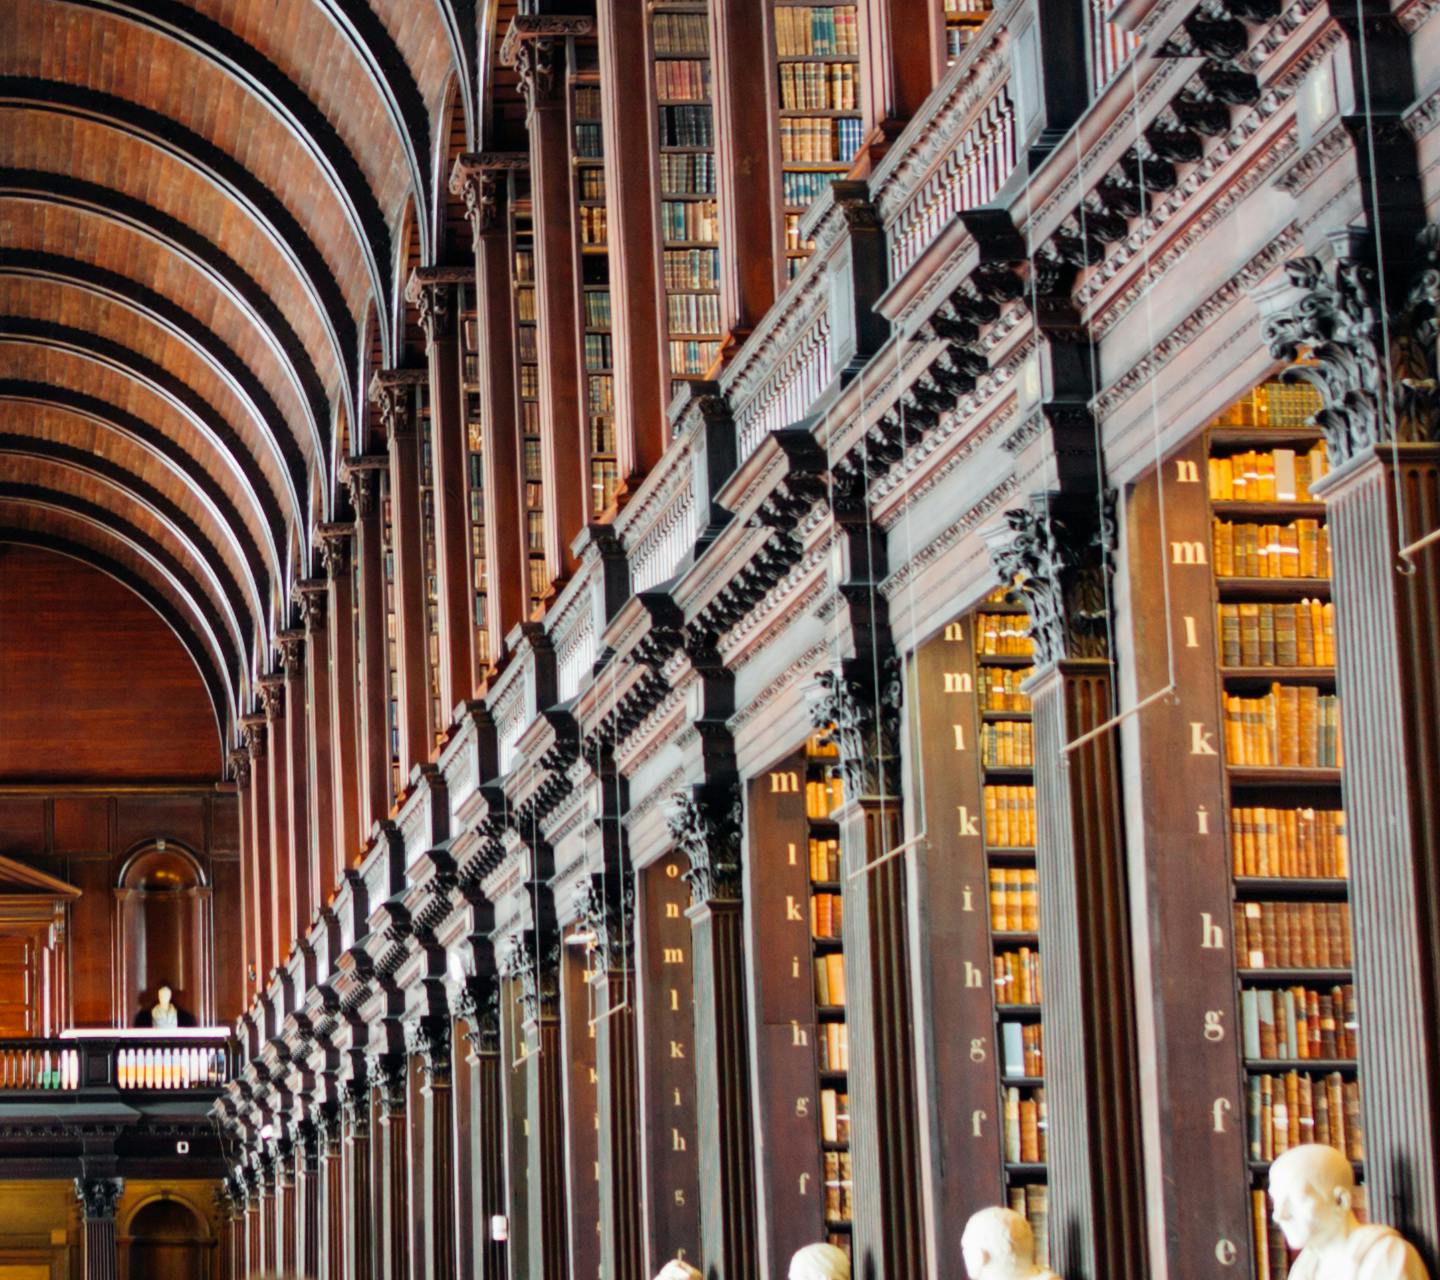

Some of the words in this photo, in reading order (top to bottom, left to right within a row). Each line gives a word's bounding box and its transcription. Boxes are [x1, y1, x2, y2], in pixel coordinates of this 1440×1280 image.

[1176, 460, 1199, 482] n
[1170, 541, 1207, 564] m
[944, 622, 963, 641] n
[1184, 616, 1199, 647] l
[944, 672, 972, 692] m
[953, 725, 965, 750] l
[1190, 723, 1217, 755] k
[770, 772, 799, 792] m
[957, 807, 979, 836] k
[1197, 806, 1210, 834] i
[667, 863, 678, 878] o
[667, 900, 679, 918] n
[786, 896, 803, 920] k
[962, 886, 974, 911] i
[1200, 913, 1224, 948] h
[664, 946, 683, 964] m
[963, 962, 982, 987] h
[670, 990, 679, 1010] l
[791, 1021, 807, 1046] h
[1204, 1010, 1224, 1041] g
[670, 1042, 684, 1058] k
[970, 1037, 986, 1062] g
[796, 1096, 809, 1117] g
[1212, 1098, 1231, 1132] f
[972, 1110, 986, 1136] f
[673, 1130, 686, 1151] h
[799, 1173, 810, 1194] f
[675, 1187, 684, 1205] g
[1215, 1238, 1236, 1265] e
